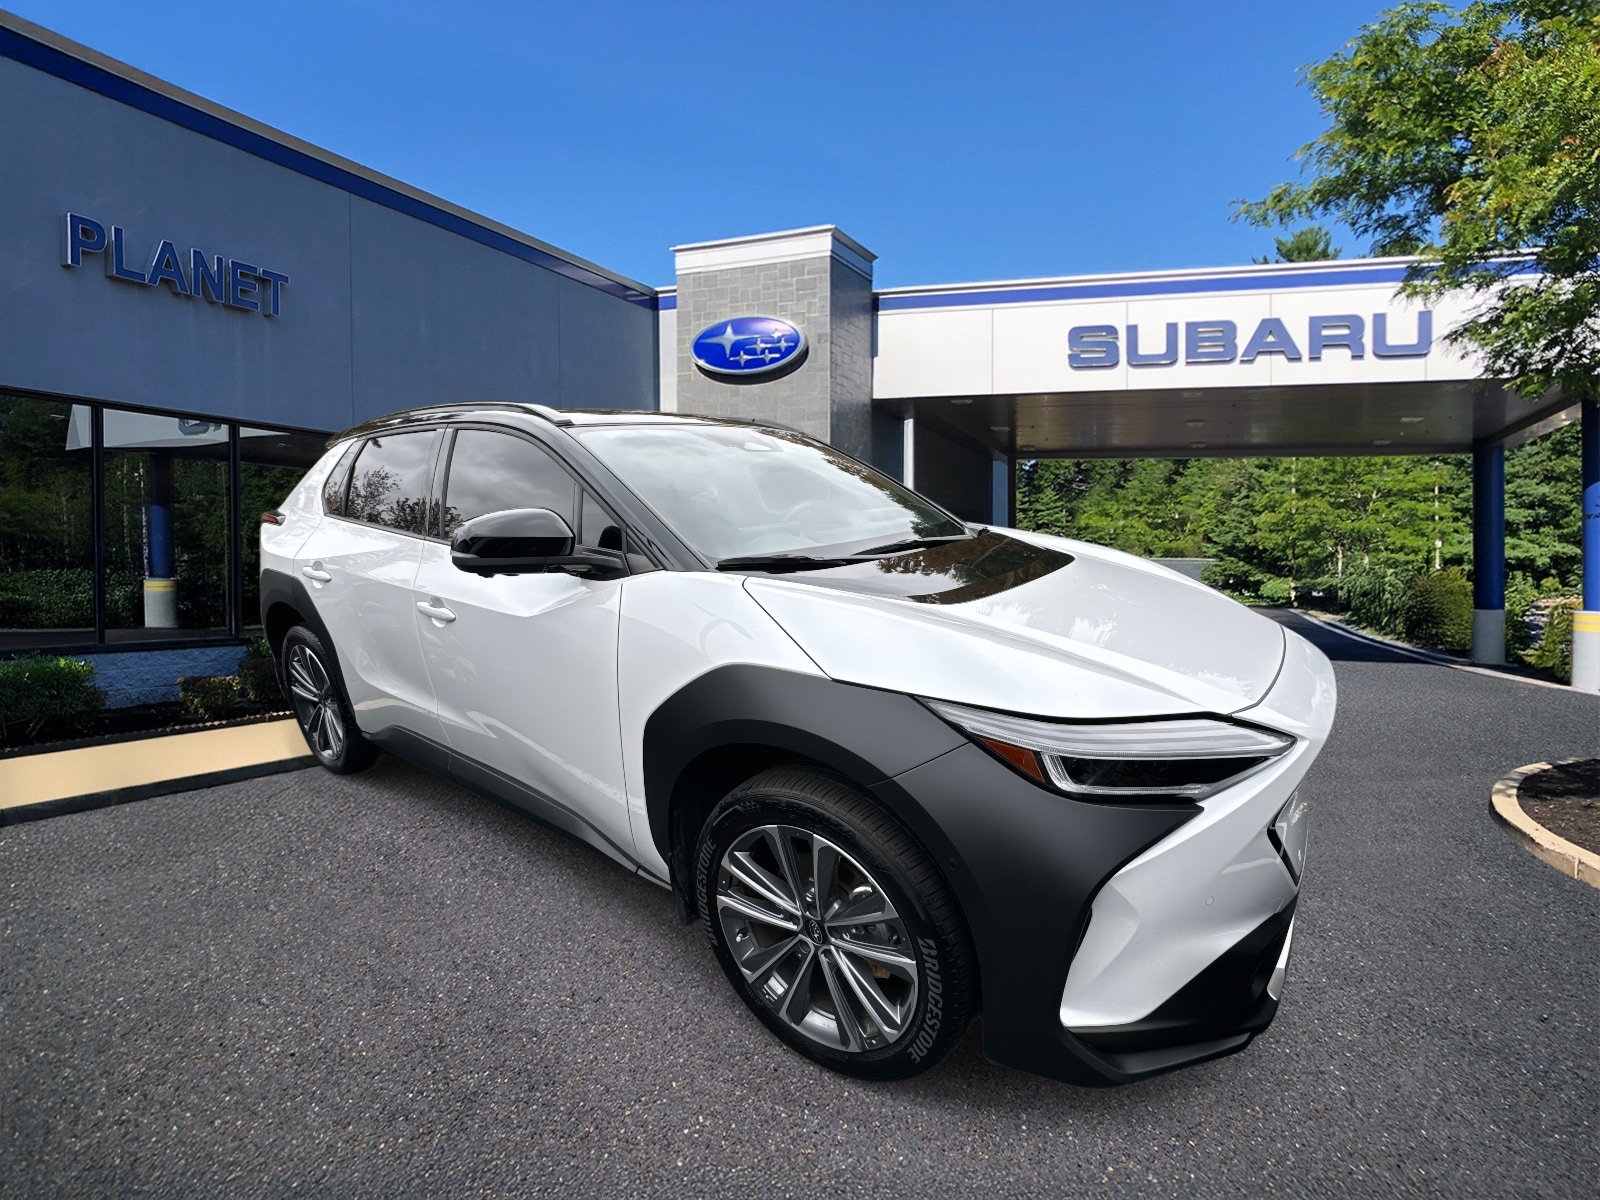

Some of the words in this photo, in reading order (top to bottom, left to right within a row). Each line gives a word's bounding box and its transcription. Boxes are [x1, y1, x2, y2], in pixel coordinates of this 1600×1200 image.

[64, 212, 290, 317] PLANET
[1067, 310, 1433, 369] SUBARU
[907, 936, 943, 1064] BRIDGESTONE
